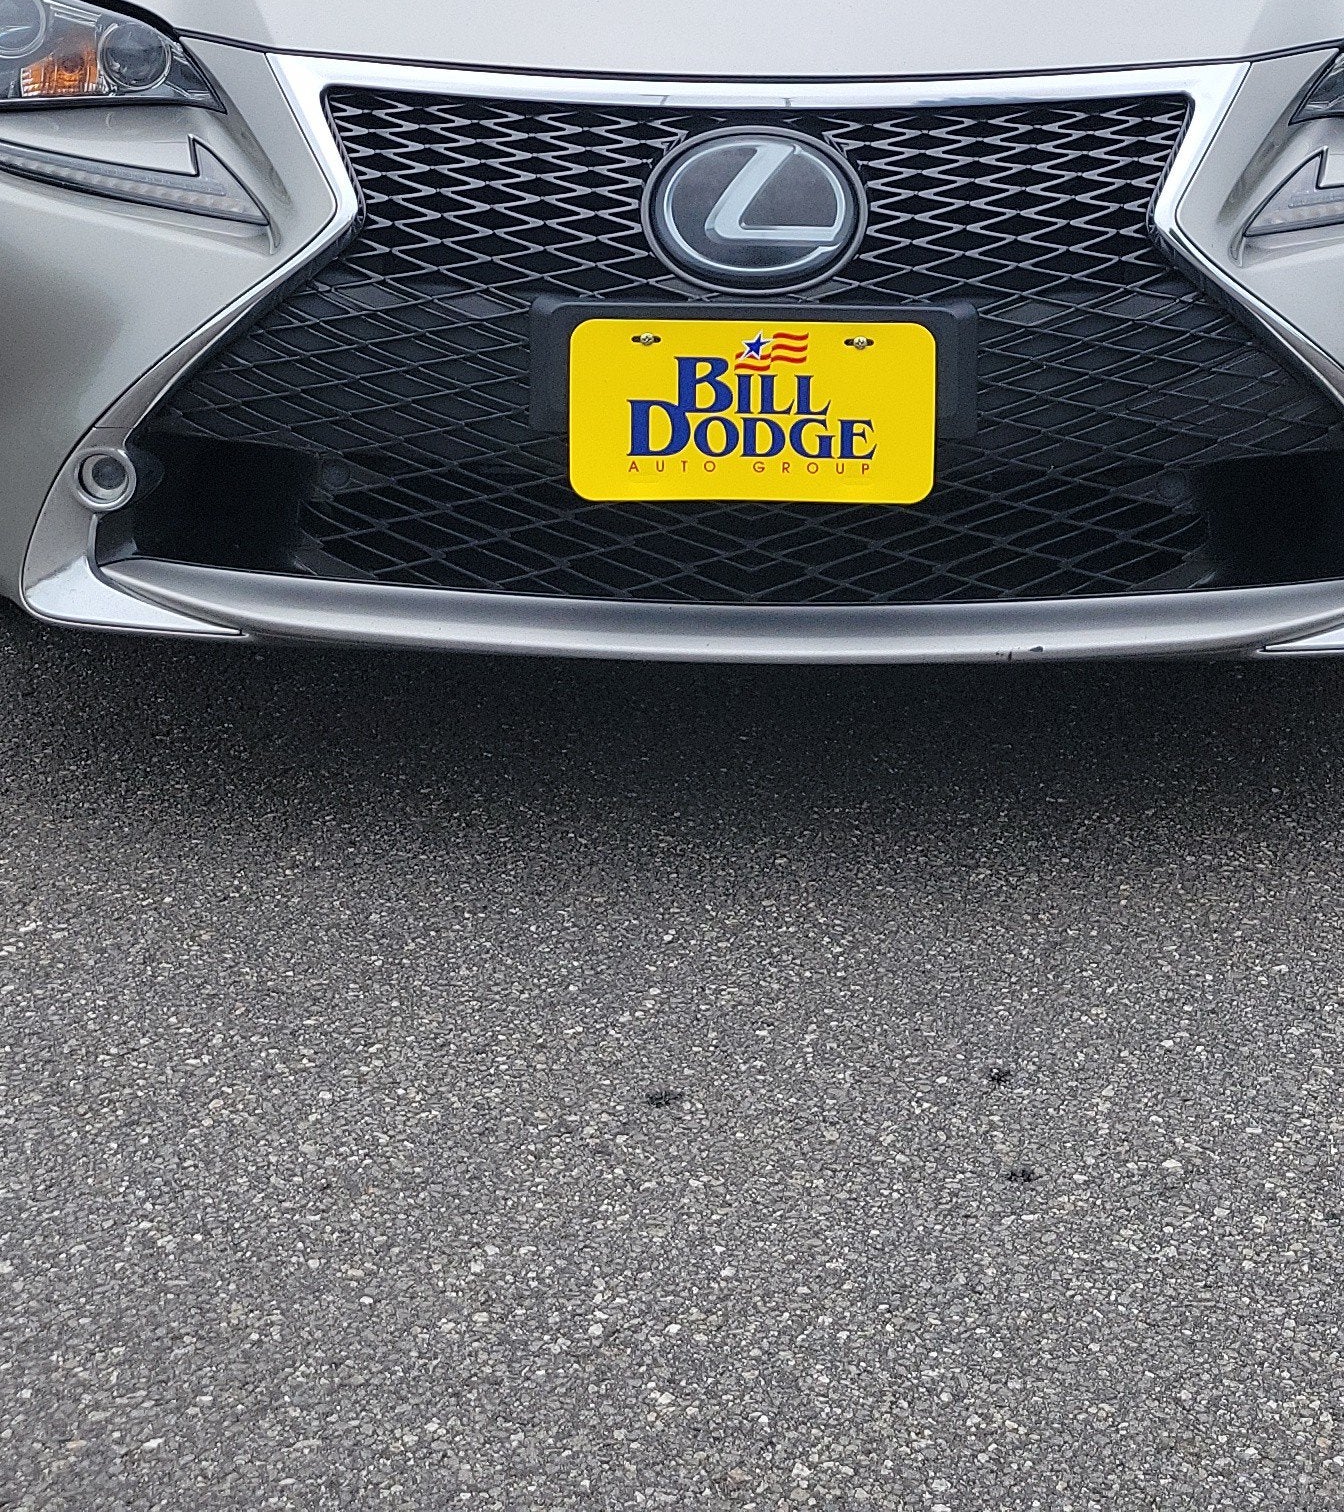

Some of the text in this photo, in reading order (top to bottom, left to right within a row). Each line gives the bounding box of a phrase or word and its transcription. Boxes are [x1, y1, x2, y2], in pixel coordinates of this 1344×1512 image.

[674, 356, 831, 416] BILL
[626, 399, 877, 460] DODGE
[628, 460, 870, 475] AUTO GROUP
